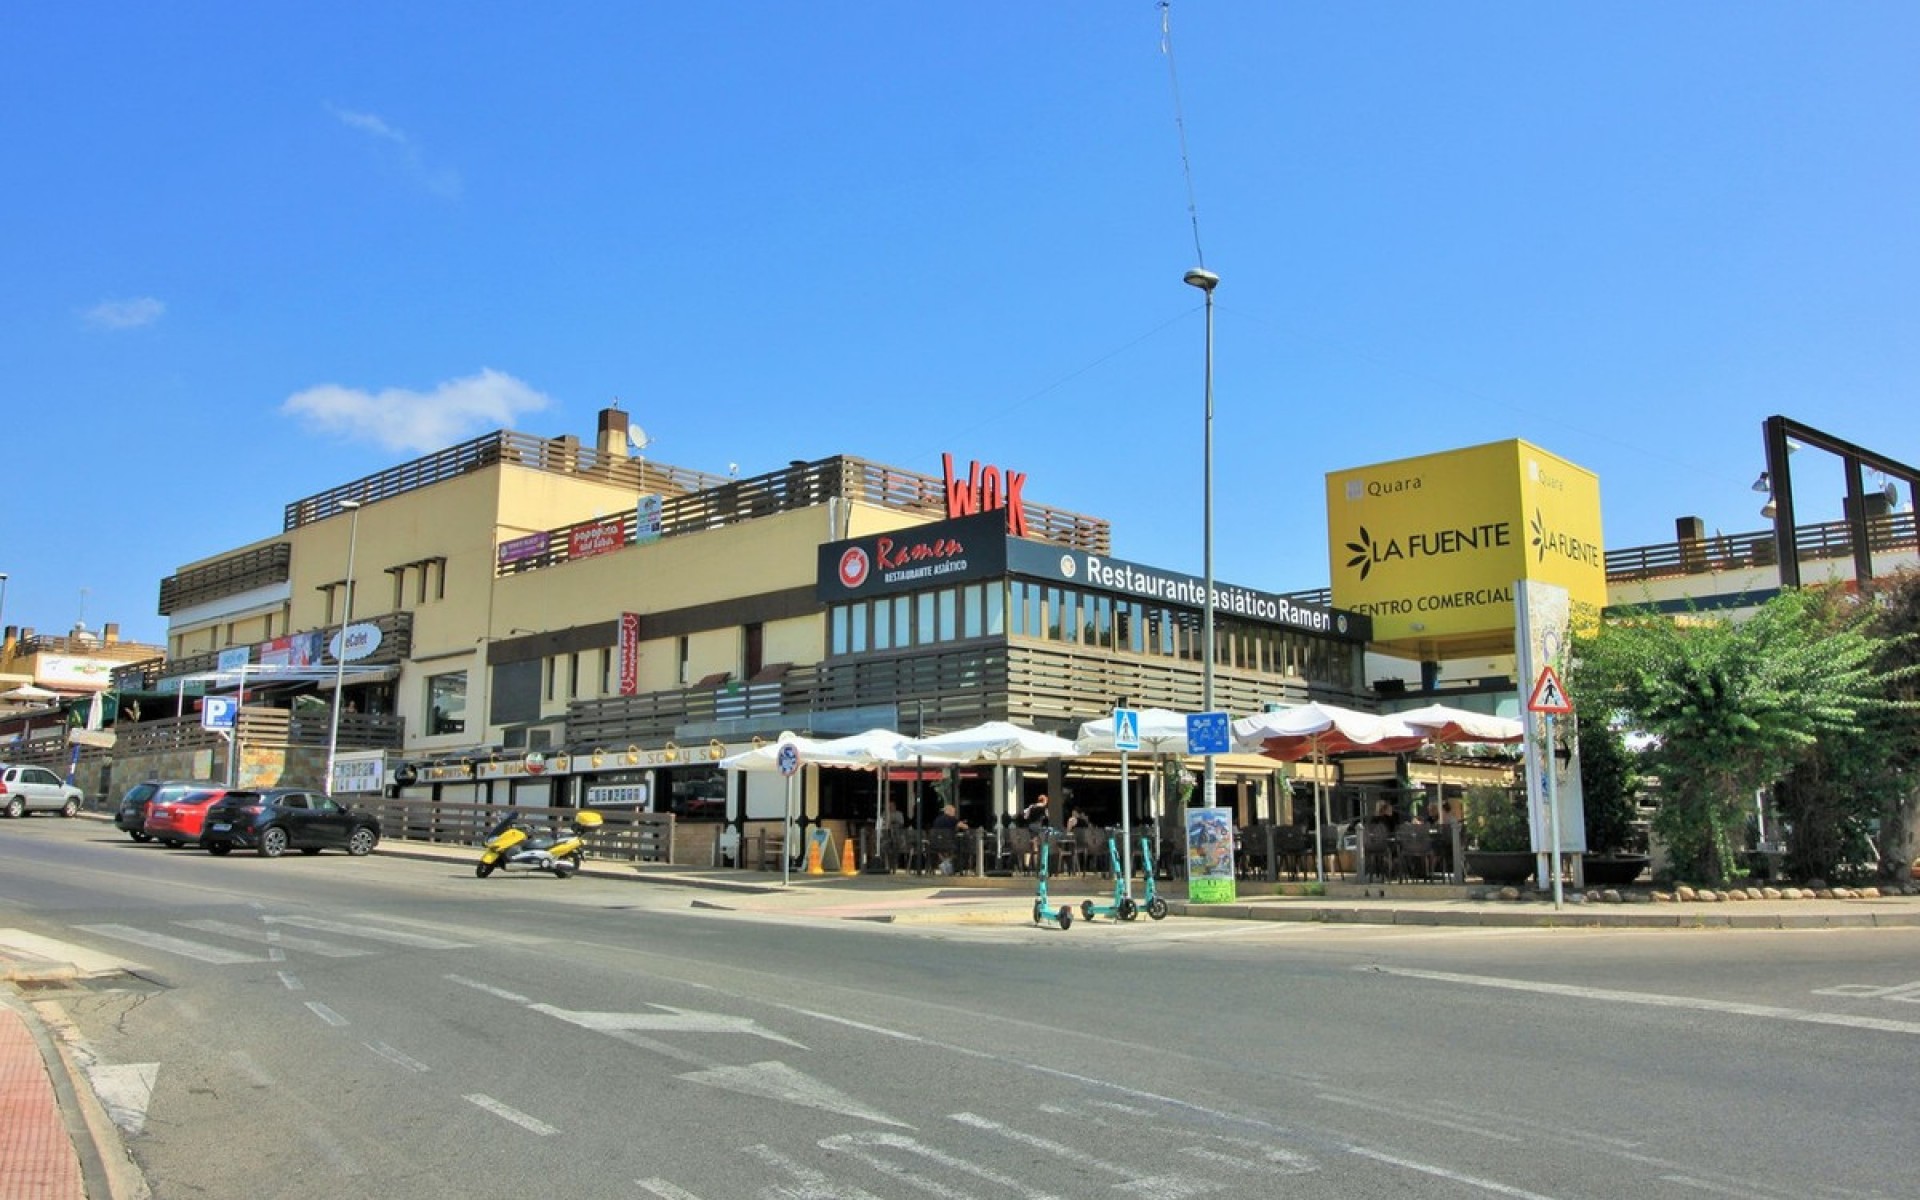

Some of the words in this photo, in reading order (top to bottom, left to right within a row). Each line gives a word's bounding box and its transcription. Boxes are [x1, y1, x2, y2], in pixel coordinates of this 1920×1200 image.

[942, 452, 1029, 537] WOK
[1368, 477, 1422, 497] Quara
[876, 536, 964, 570] Ramen
[1372, 538, 1404, 563] LA
[1408, 522, 1511, 558] FUENTE
[1559, 533, 1599, 568] FUENTE
[884, 566, 932, 583] RESTAURANTE
[934, 559, 967, 576] ASIÁTICO
[1087, 556, 1206, 604] Restaurante
[1212, 586, 1276, 618] asiático
[1279, 599, 1331, 632] Ramen
[1417, 586, 1514, 612] COMERCIAL
